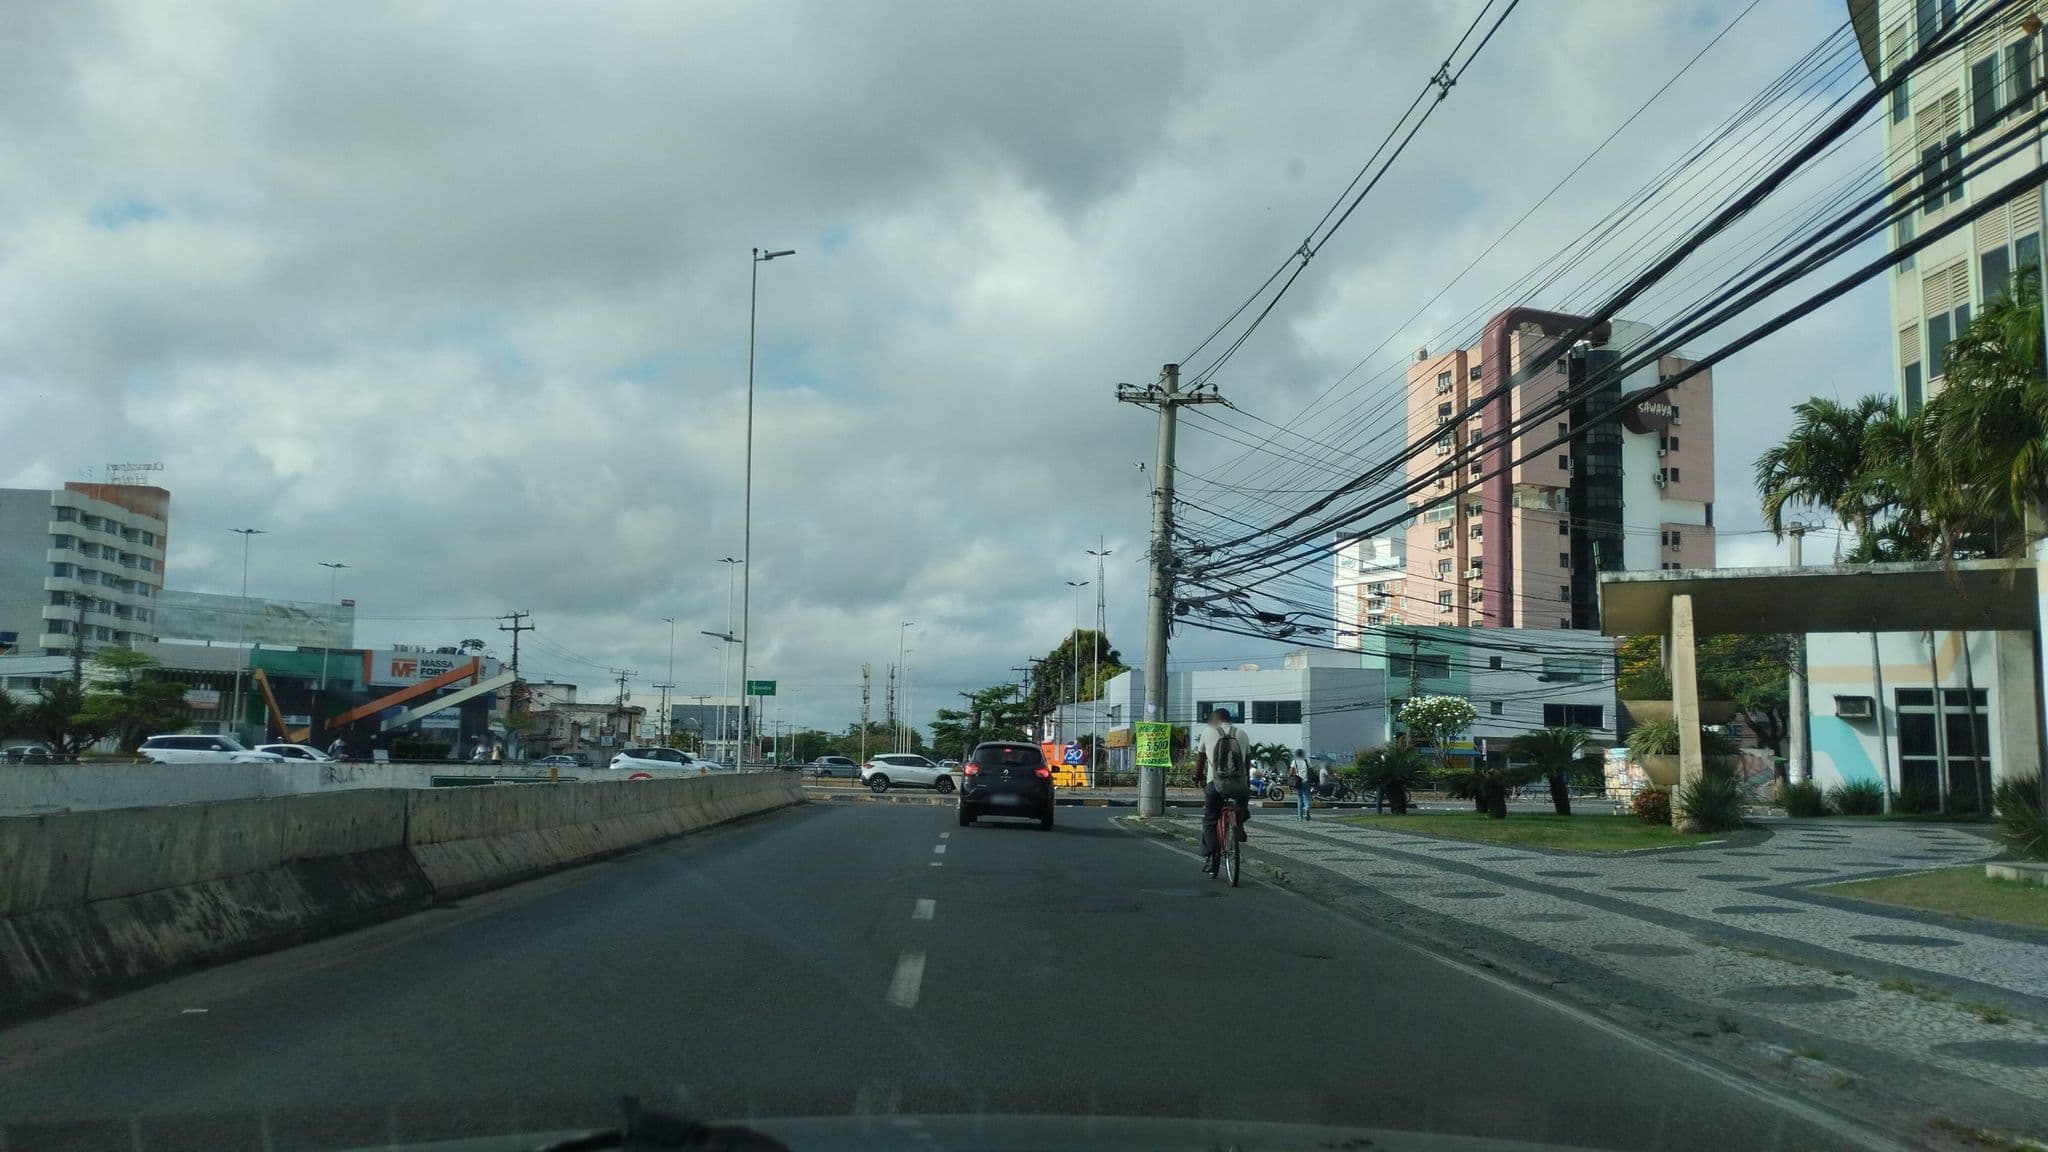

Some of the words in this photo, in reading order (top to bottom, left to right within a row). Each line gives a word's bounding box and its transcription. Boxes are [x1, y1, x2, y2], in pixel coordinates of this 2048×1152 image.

[1638, 401, 1672, 416] SAWAYA
[392, 662, 417, 678] MF
[420, 660, 454, 668] MASSA
